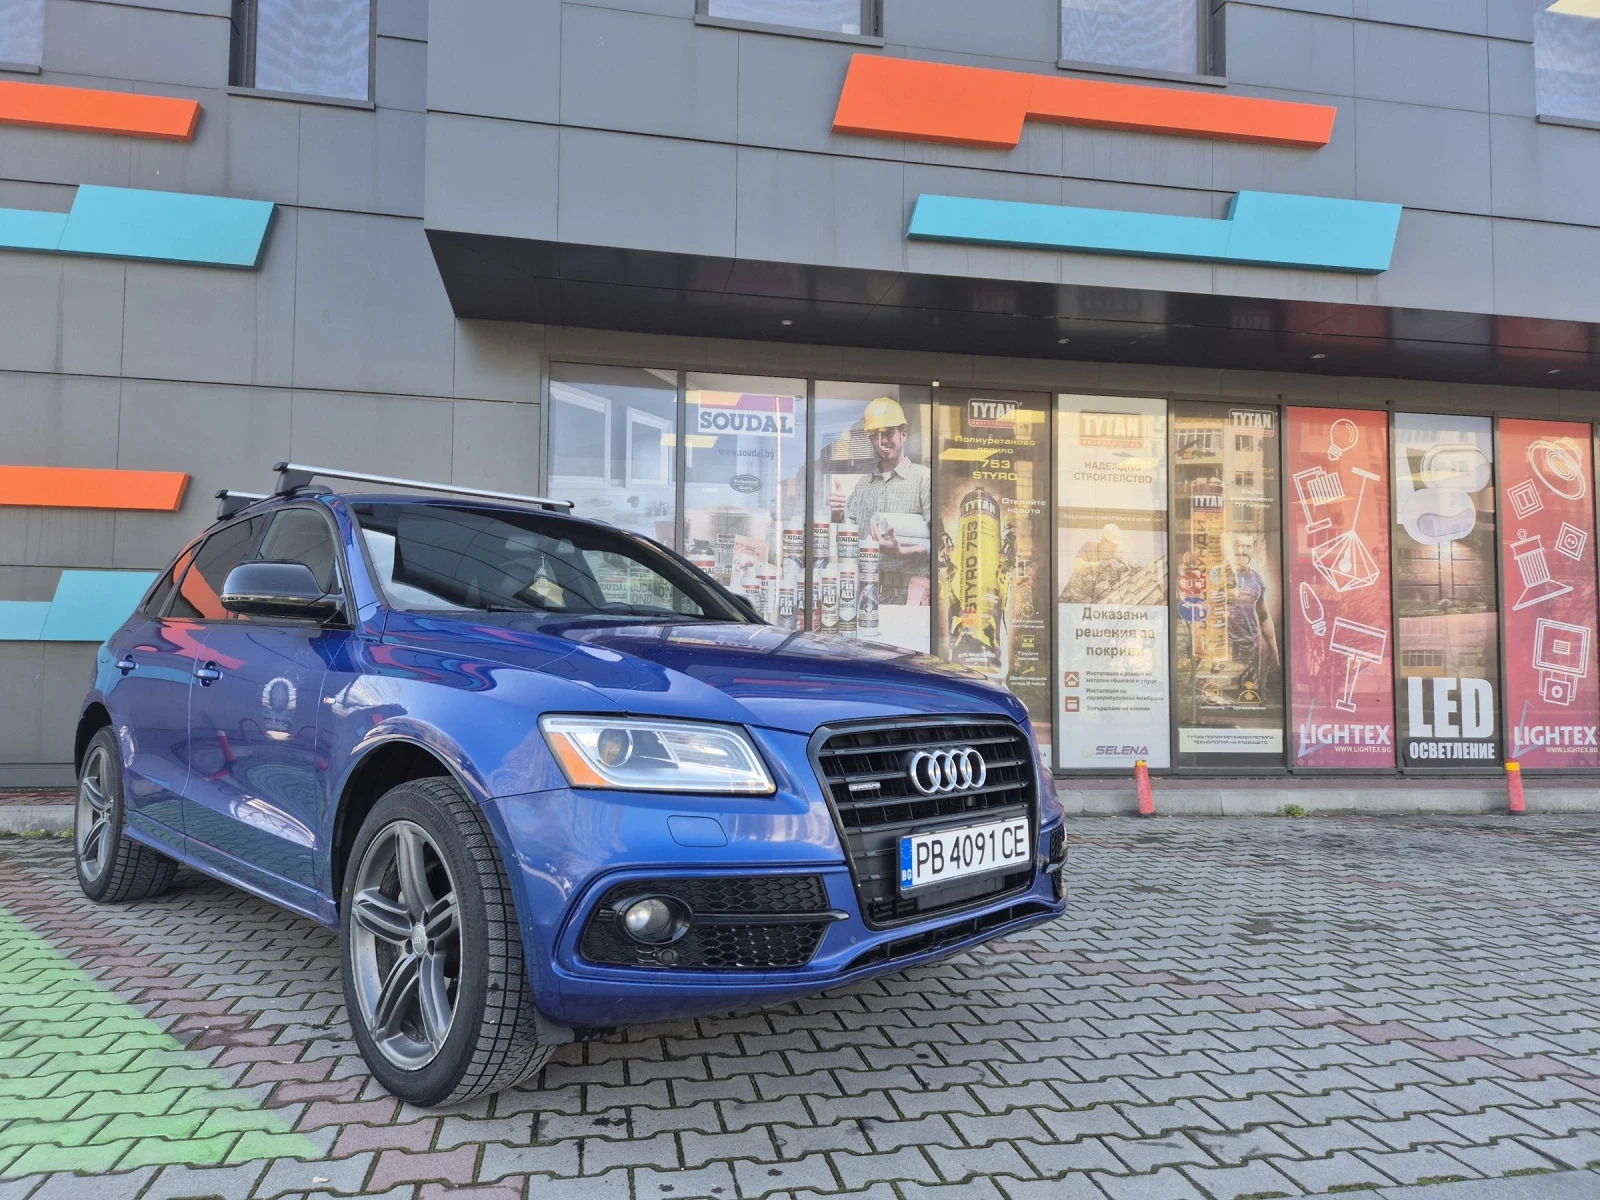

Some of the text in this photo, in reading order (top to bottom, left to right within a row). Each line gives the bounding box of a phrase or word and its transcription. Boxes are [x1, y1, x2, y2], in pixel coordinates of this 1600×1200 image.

[972, 402, 1015, 418] TYTAN
[700, 412, 792, 434] SOUDAL
[1082, 415, 1138, 437] TYTAN
[1232, 412, 1272, 428] TYTAN
[954, 436, 1035, 446] Полиуретаново
[718, 448, 774, 460] www.soudal.bg
[982, 460, 1010, 468] 753
[972, 471, 1018, 480] STYRO
[1074, 472, 1152, 483] СТРОИТЕЛСТВО
[964, 500, 996, 514] TYTAN
[966, 520, 978, 548] 753
[1082, 607, 1148, 621] Доказани
[1076, 628, 1155, 639] решения за
[1408, 676, 1494, 738] LED
[1300, 723, 1390, 745] LIGHTEX
[1514, 726, 1598, 746] LIGHTEX
[1095, 746, 1148, 755] SELENA
[1410, 742, 1495, 759] ОСВЕТЛЕНИЕ
[916, 825, 1026, 878] PB 4091 CE
[902, 869, 912, 881] BG
